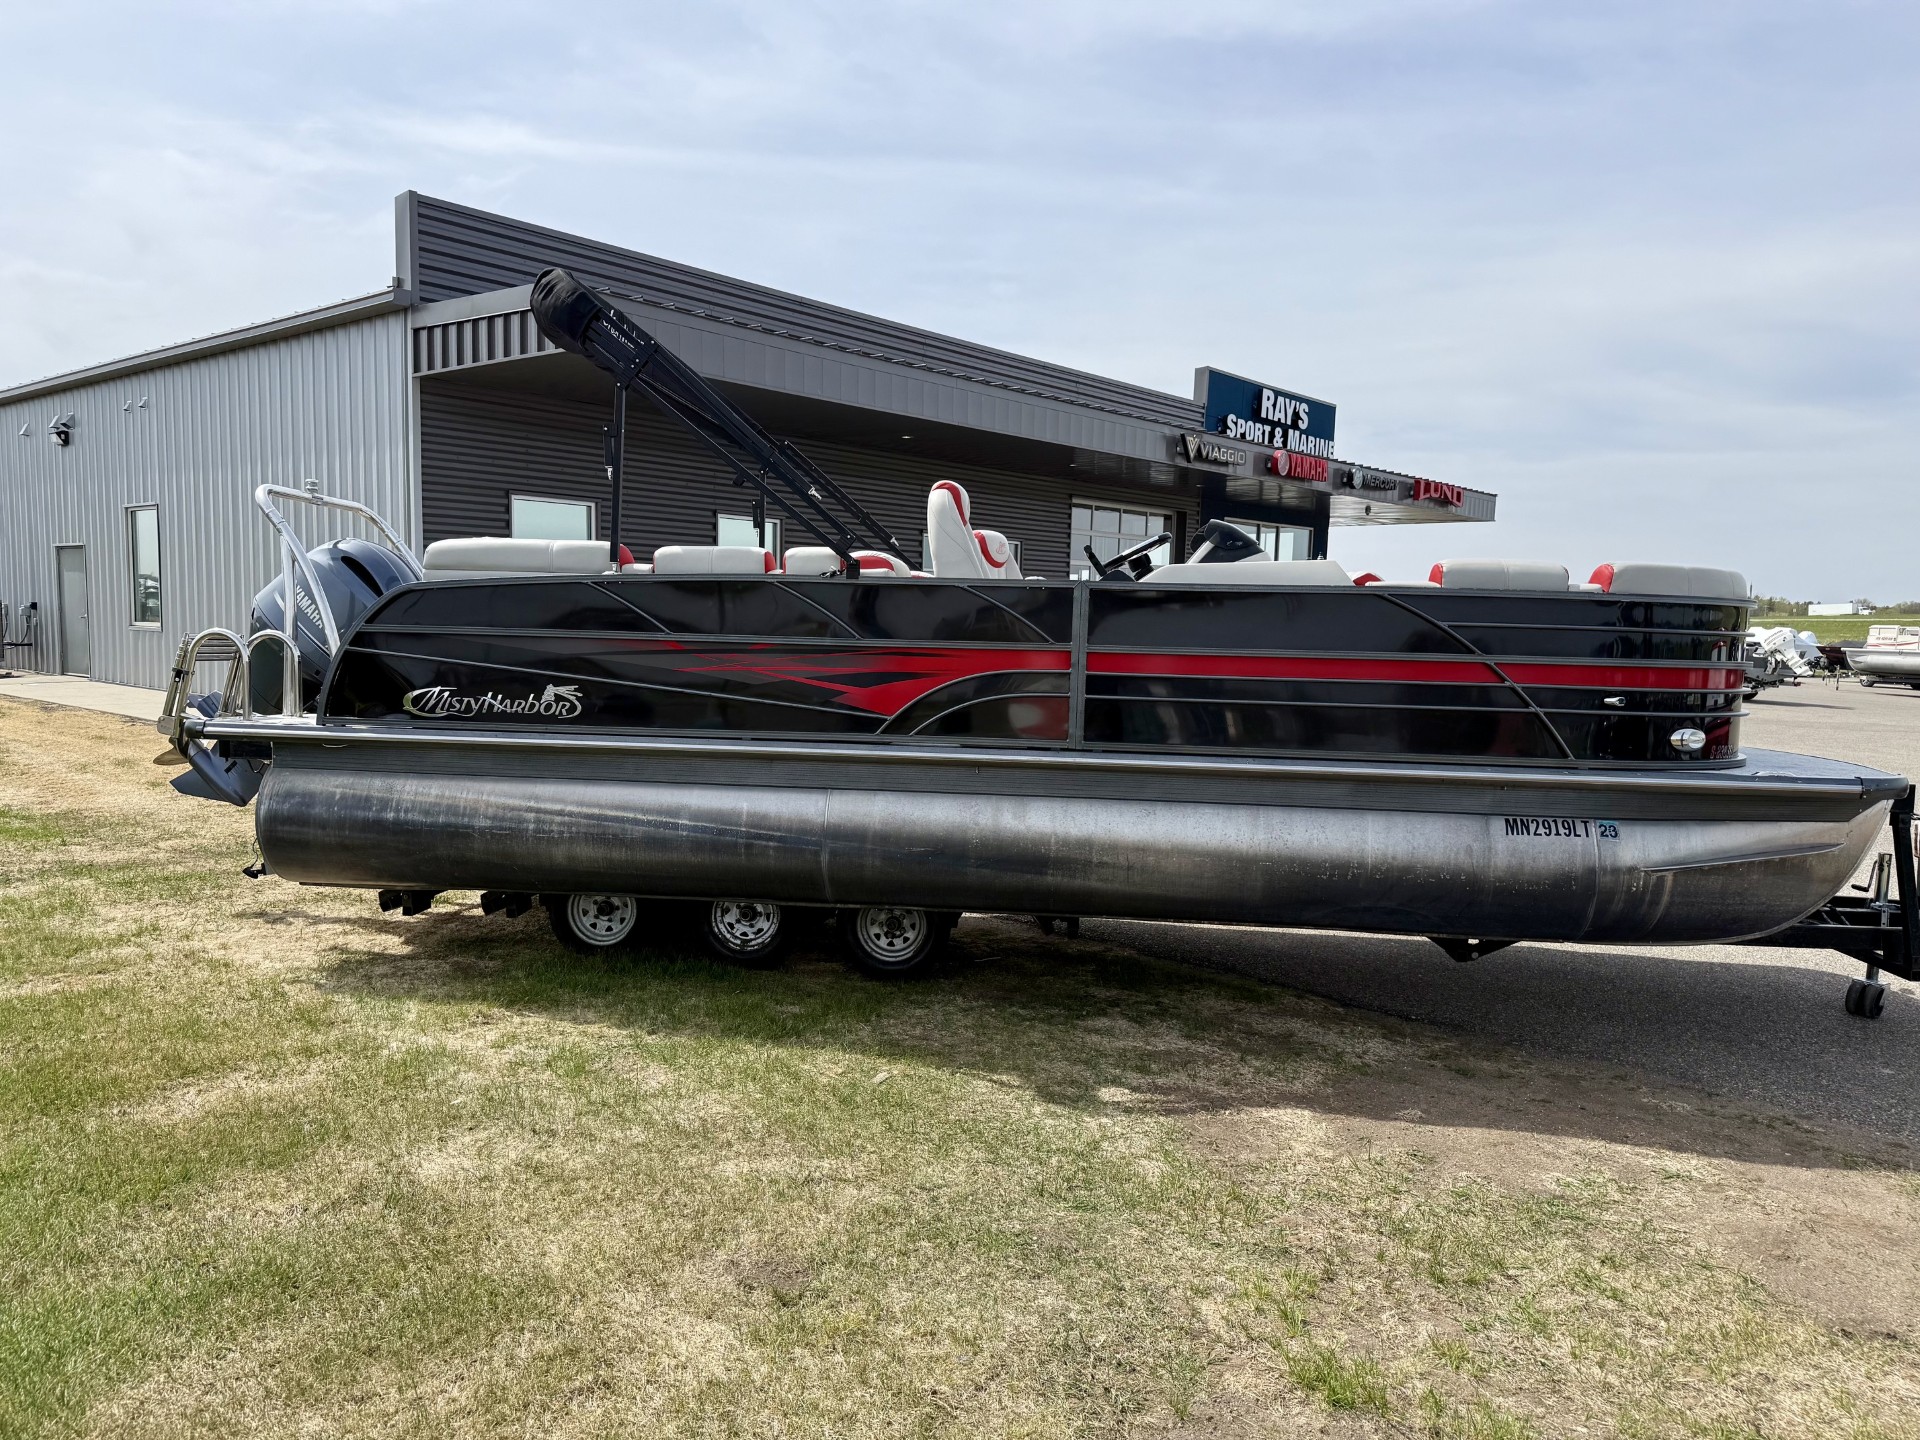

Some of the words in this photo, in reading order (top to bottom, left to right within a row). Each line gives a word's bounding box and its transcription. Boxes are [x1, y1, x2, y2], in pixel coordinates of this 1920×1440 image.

[1261, 388, 1309, 430] RAY'S
[1226, 413, 1272, 445] SPORT
[1273, 426, 1284, 448] &
[1287, 429, 1336, 459] MARINE
[1200, 441, 1246, 464] VIAGGIO
[1289, 452, 1329, 482] YAMAHA
[1363, 474, 1400, 491] MERCURY
[1418, 479, 1465, 508] LUND
[1504, 818, 1590, 838] MN2919LT
[1599, 824, 1618, 838] 23
